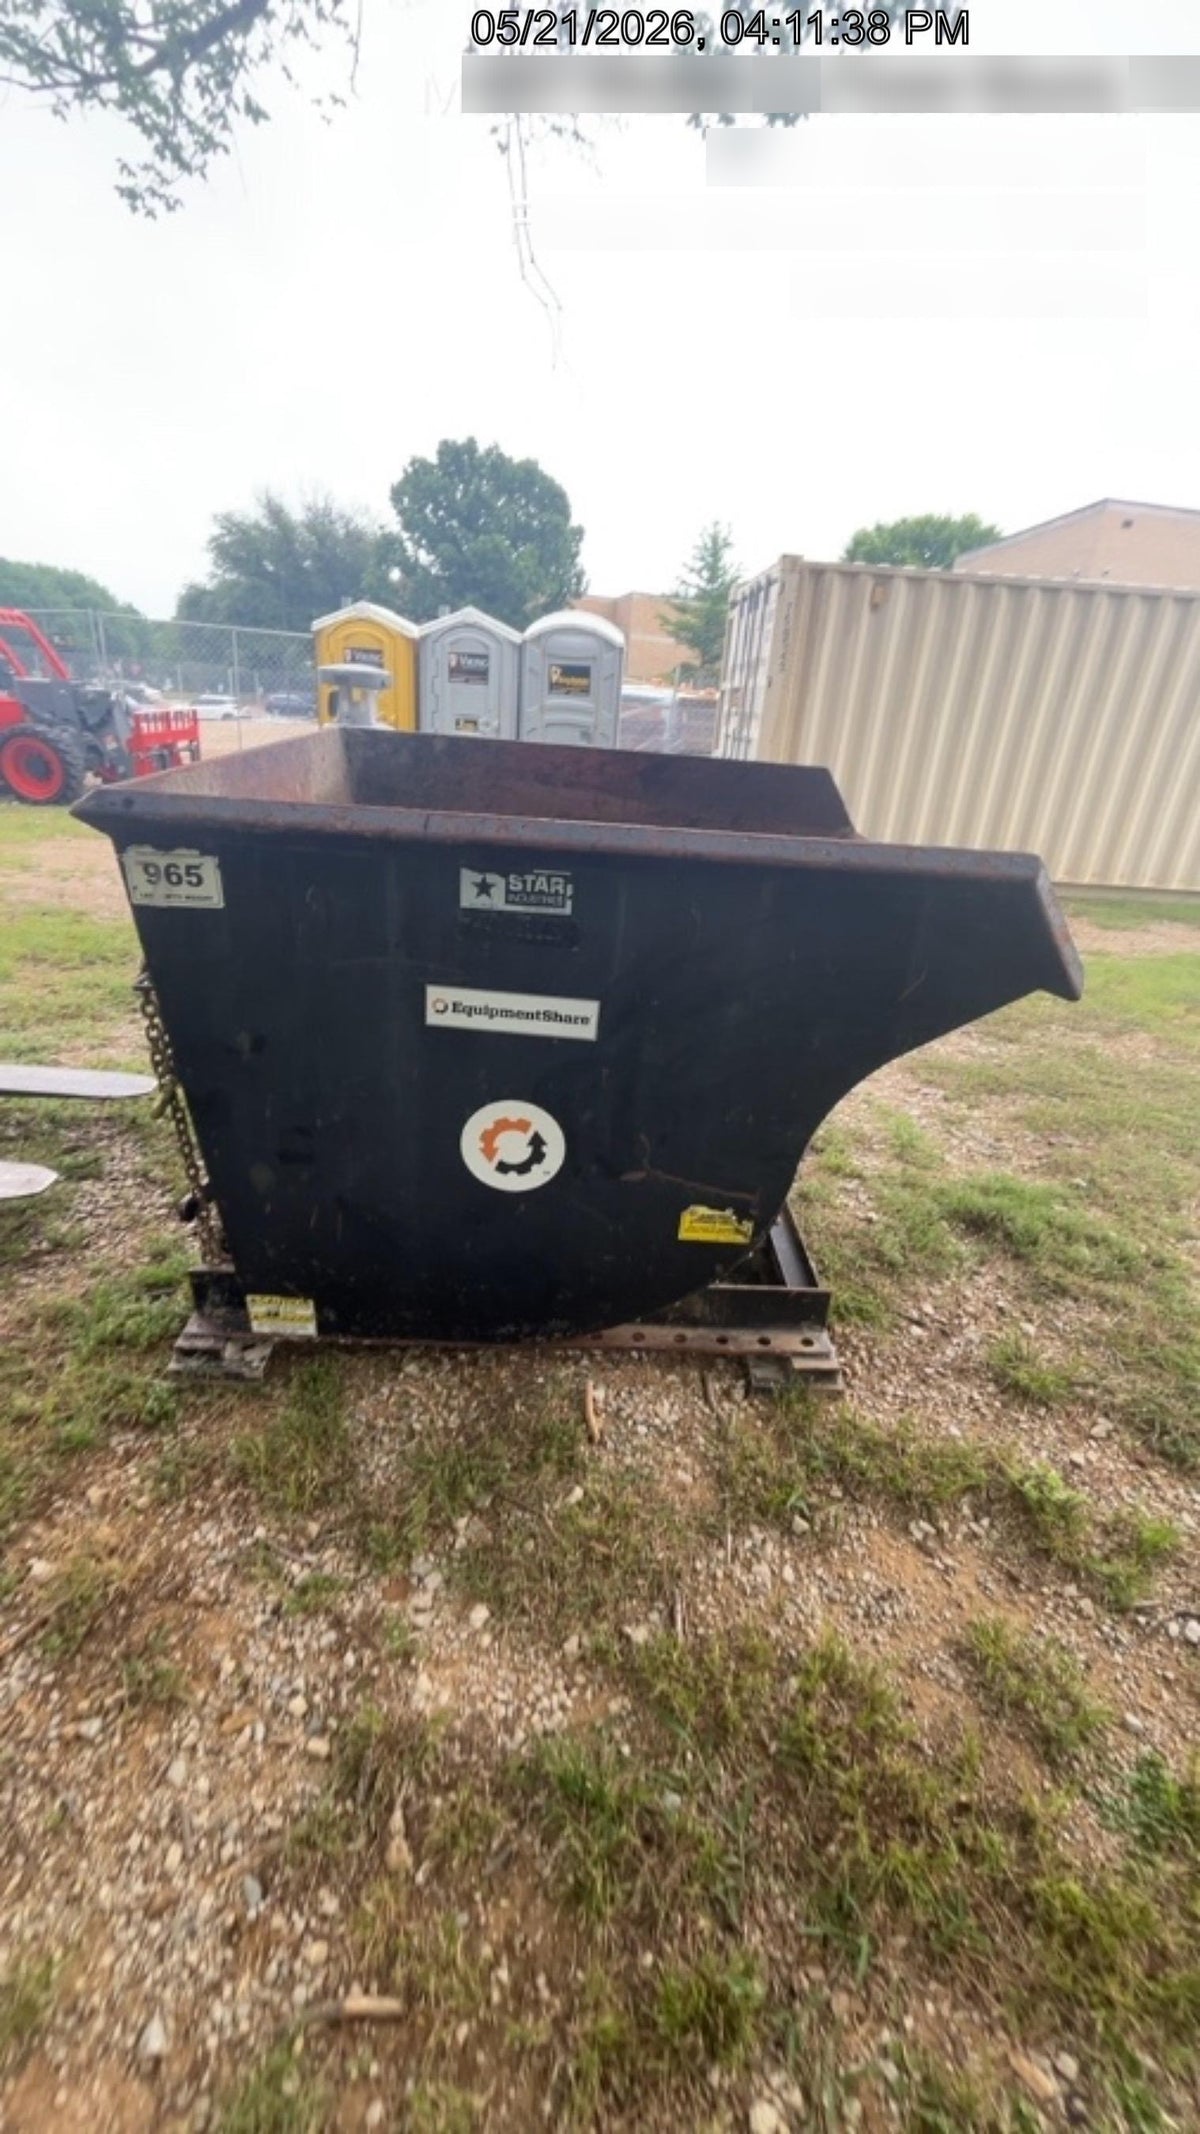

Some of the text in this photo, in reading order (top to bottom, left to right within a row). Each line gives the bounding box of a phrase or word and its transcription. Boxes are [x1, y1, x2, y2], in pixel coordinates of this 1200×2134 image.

[143, 863, 204, 887] 965
[508, 873, 565, 894] STAR
[452, 1001, 591, 1025] EquipmentShare
